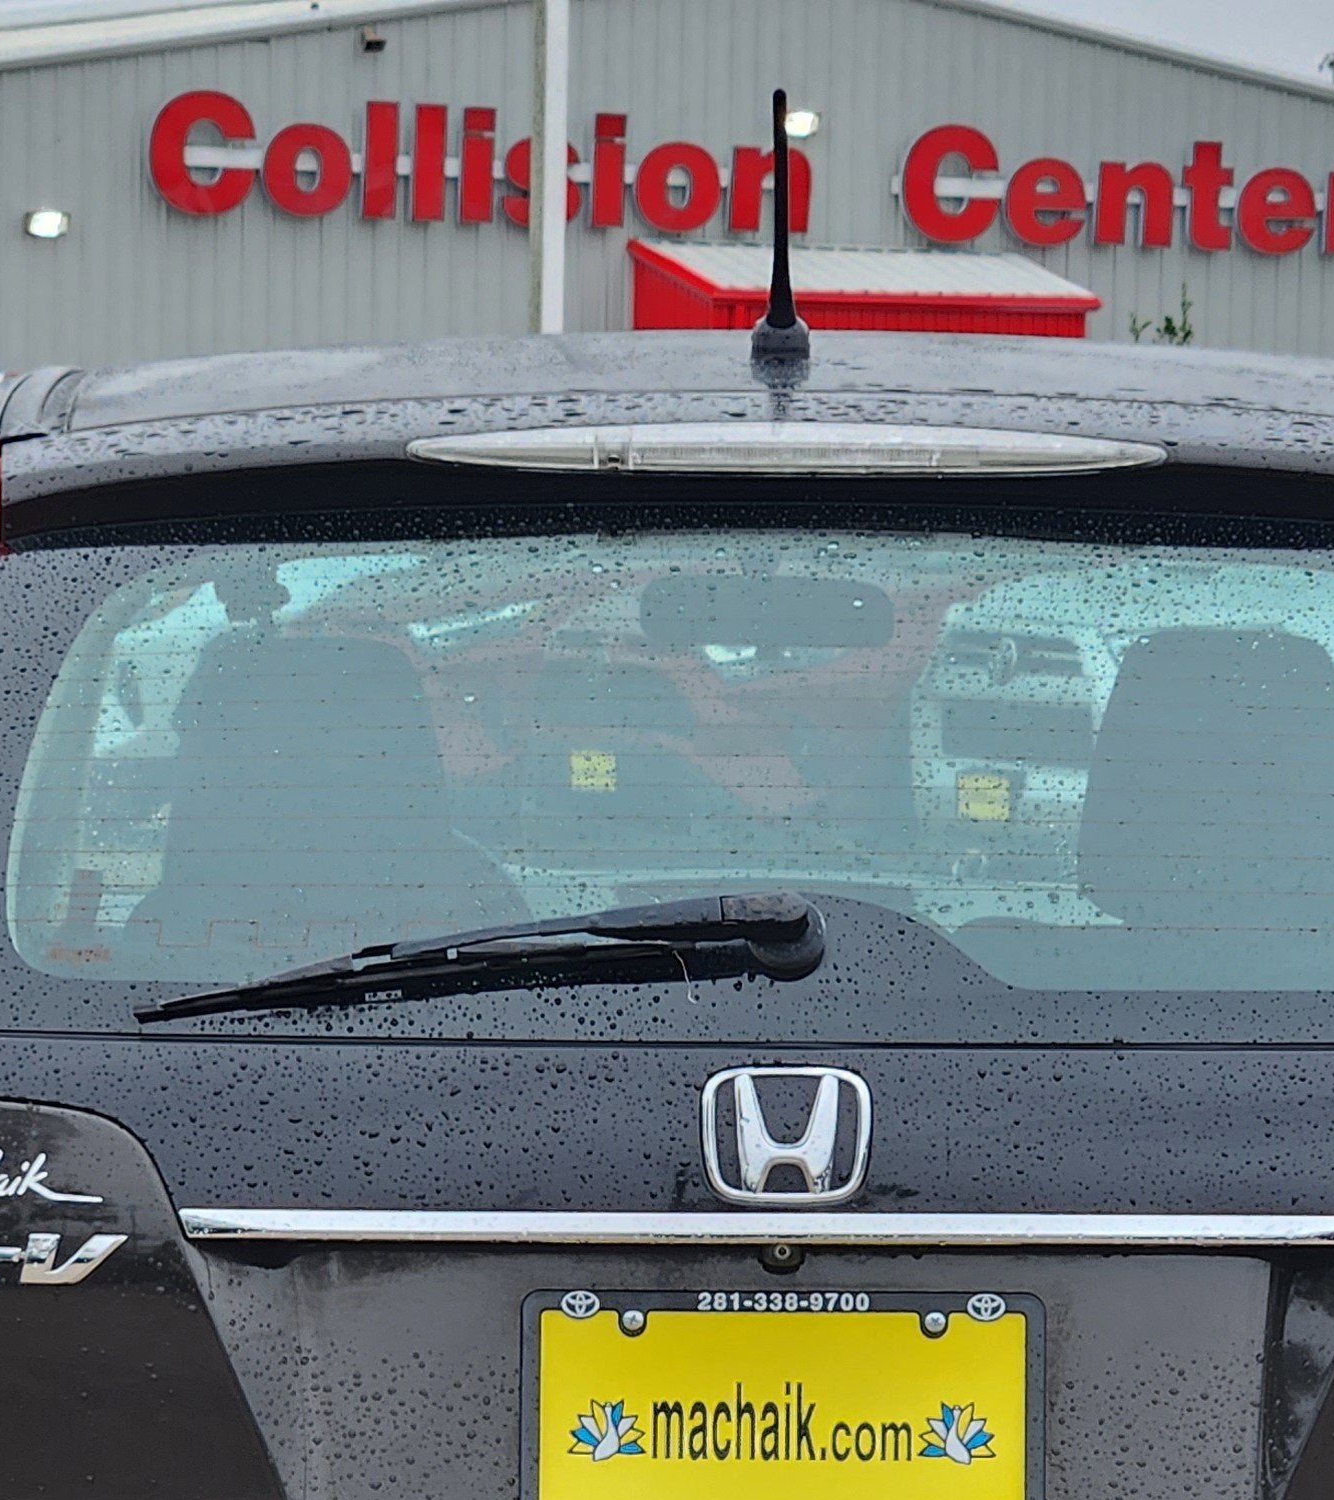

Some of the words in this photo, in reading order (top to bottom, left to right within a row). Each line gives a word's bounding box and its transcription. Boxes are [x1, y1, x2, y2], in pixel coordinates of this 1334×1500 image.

[151, 91, 812, 233] Collision
[697, 1292, 870, 1312] 281-338-9700
[650, 1381, 913, 1462] machaik.com
